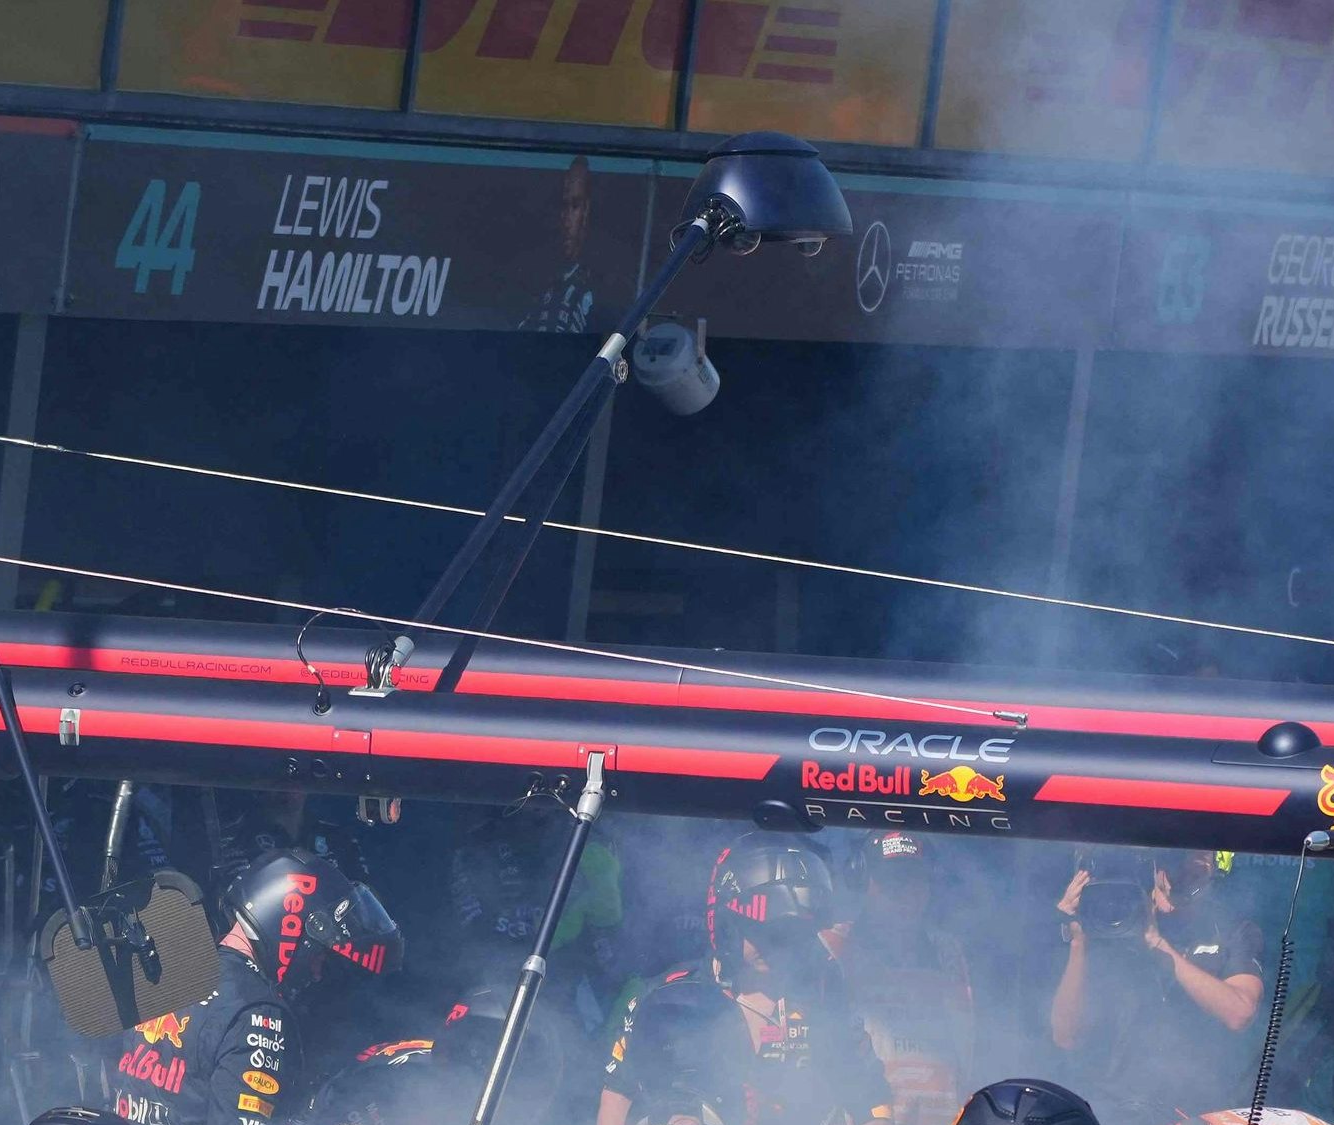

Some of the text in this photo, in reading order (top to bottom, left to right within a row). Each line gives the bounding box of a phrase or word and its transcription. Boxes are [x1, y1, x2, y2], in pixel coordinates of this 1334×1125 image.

[273, 174, 388, 239] LEWIS
[116, 180, 201, 295] 44
[257, 250, 449, 316] HAMILTON
[896, 263, 960, 282] PETRONAS
[120, 656, 272, 674] REDBULLRACING.COM
[808, 727, 1016, 763] ORACLE
[805, 804, 1012, 831] RACING
[251, 1014, 282, 1032] Mobil
[247, 1033, 280, 1053] Claro
[265, 1056, 279, 1072] Sui
